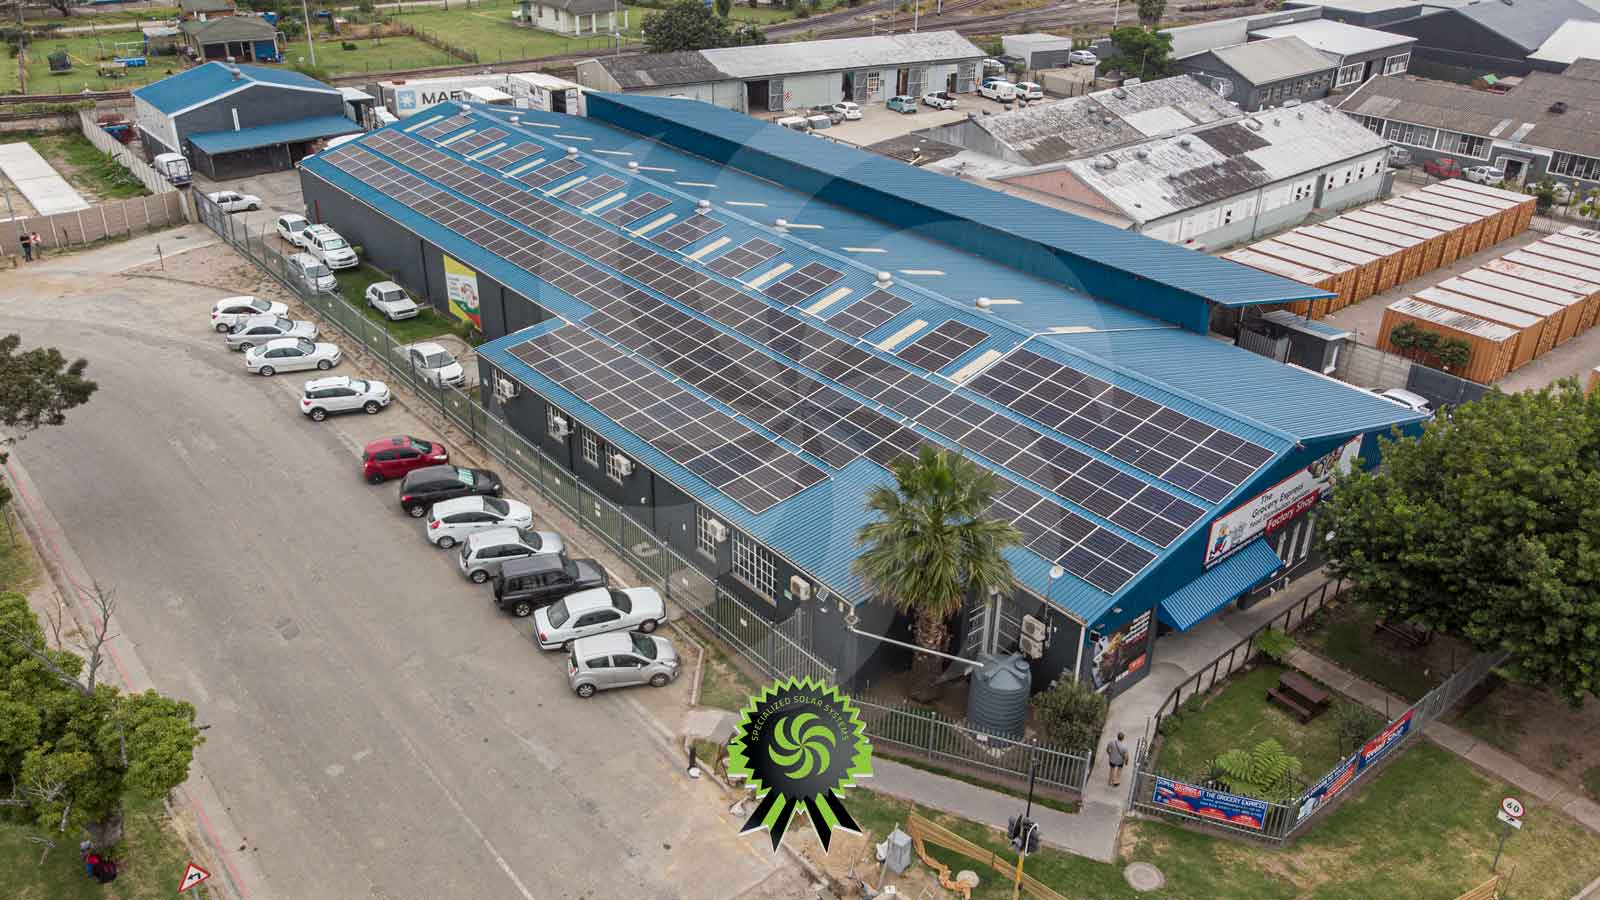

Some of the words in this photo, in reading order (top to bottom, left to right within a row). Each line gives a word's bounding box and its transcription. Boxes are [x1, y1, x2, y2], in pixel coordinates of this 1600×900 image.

[1261, 493, 1272, 504] The
[1252, 499, 1278, 518] Grocery
[1268, 508, 1294, 528] Factory
[1296, 495, 1315, 512] Shop
[1206, 791, 1216, 800] THE
[1216, 794, 1241, 804] GROCERY
[1241, 799, 1266, 810] EXPRESS
[1506, 802, 1520, 813] 60
